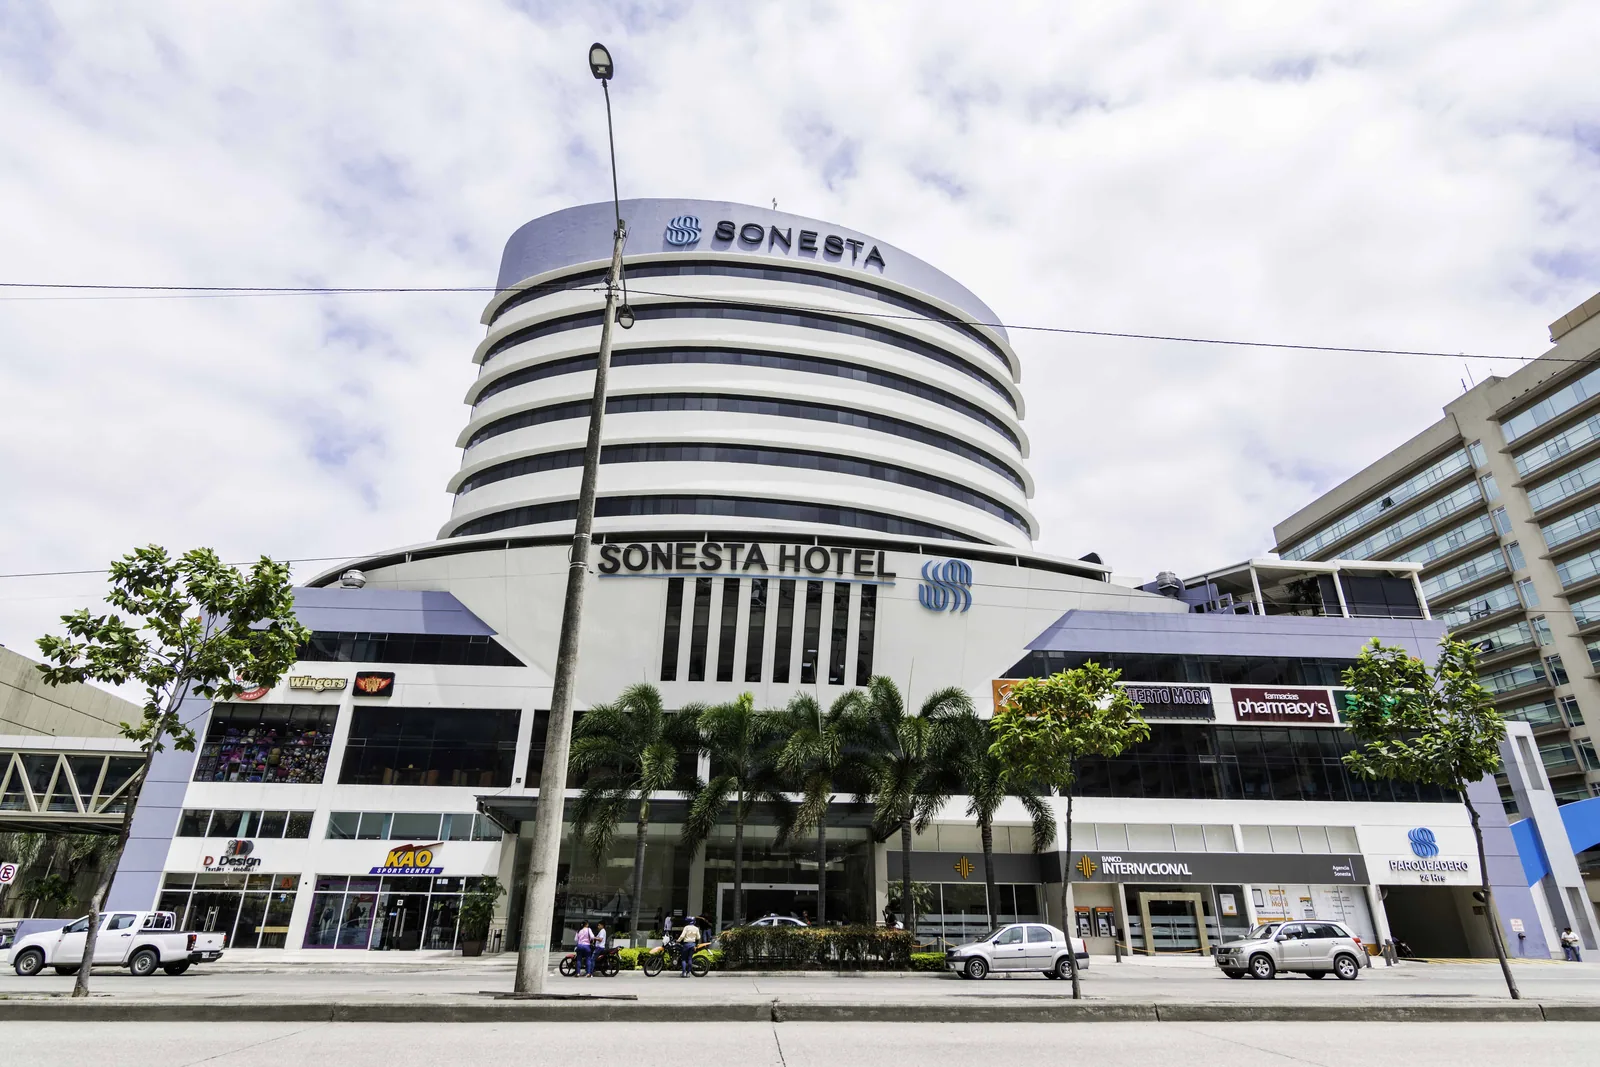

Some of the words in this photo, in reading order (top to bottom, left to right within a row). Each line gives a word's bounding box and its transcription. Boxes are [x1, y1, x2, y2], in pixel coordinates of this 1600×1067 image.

[714, 219, 886, 267] SONESTA
[597, 542, 769, 574] SONESTA
[778, 544, 897, 579] HOTEL
[289, 675, 346, 692] Wingers
[1264, 692, 1300, 700] farmacias
[203, 855, 214, 866] D
[218, 855, 262, 868] Design
[384, 849, 434, 868] KAO
[1101, 855, 1122, 863] BANCO
[1102, 862, 1193, 875] INTERNACIONAL
[1388, 860, 1469, 872] PARQUEADERO
[1420, 873, 1430, 882] 24
